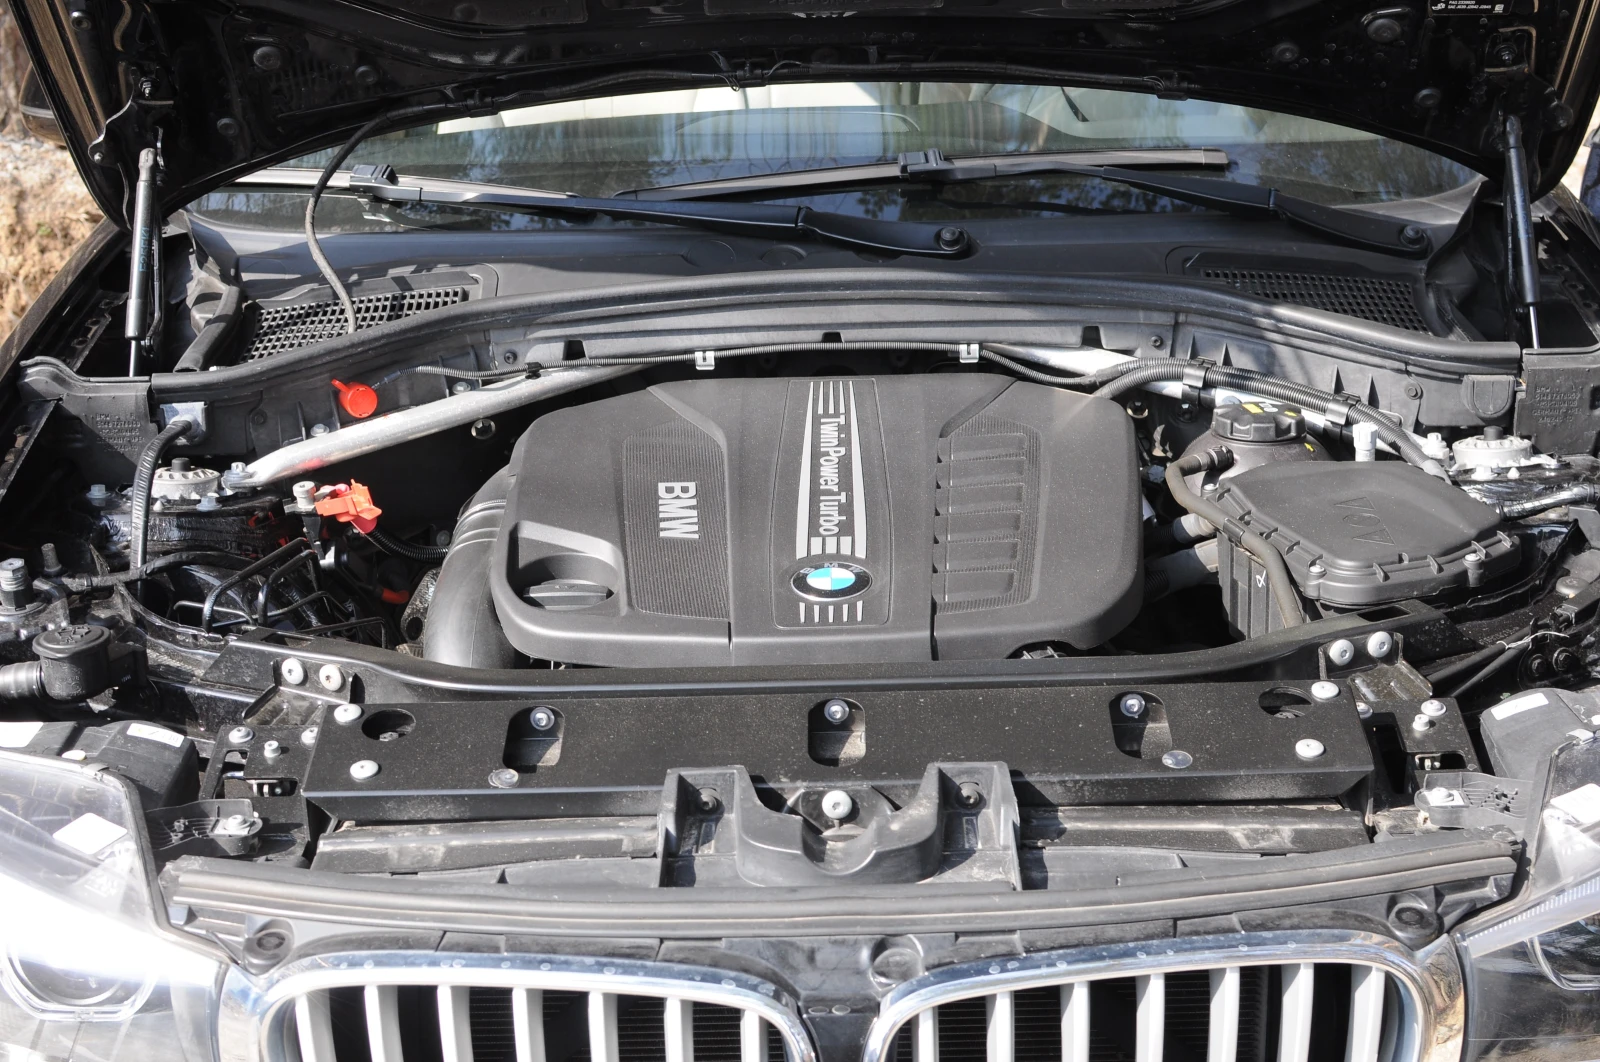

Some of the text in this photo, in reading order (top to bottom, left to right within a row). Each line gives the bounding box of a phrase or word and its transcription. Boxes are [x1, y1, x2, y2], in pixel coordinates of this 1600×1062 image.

[658, 481, 700, 539] BMW
[819, 414, 847, 535] TwinPower Turbo
